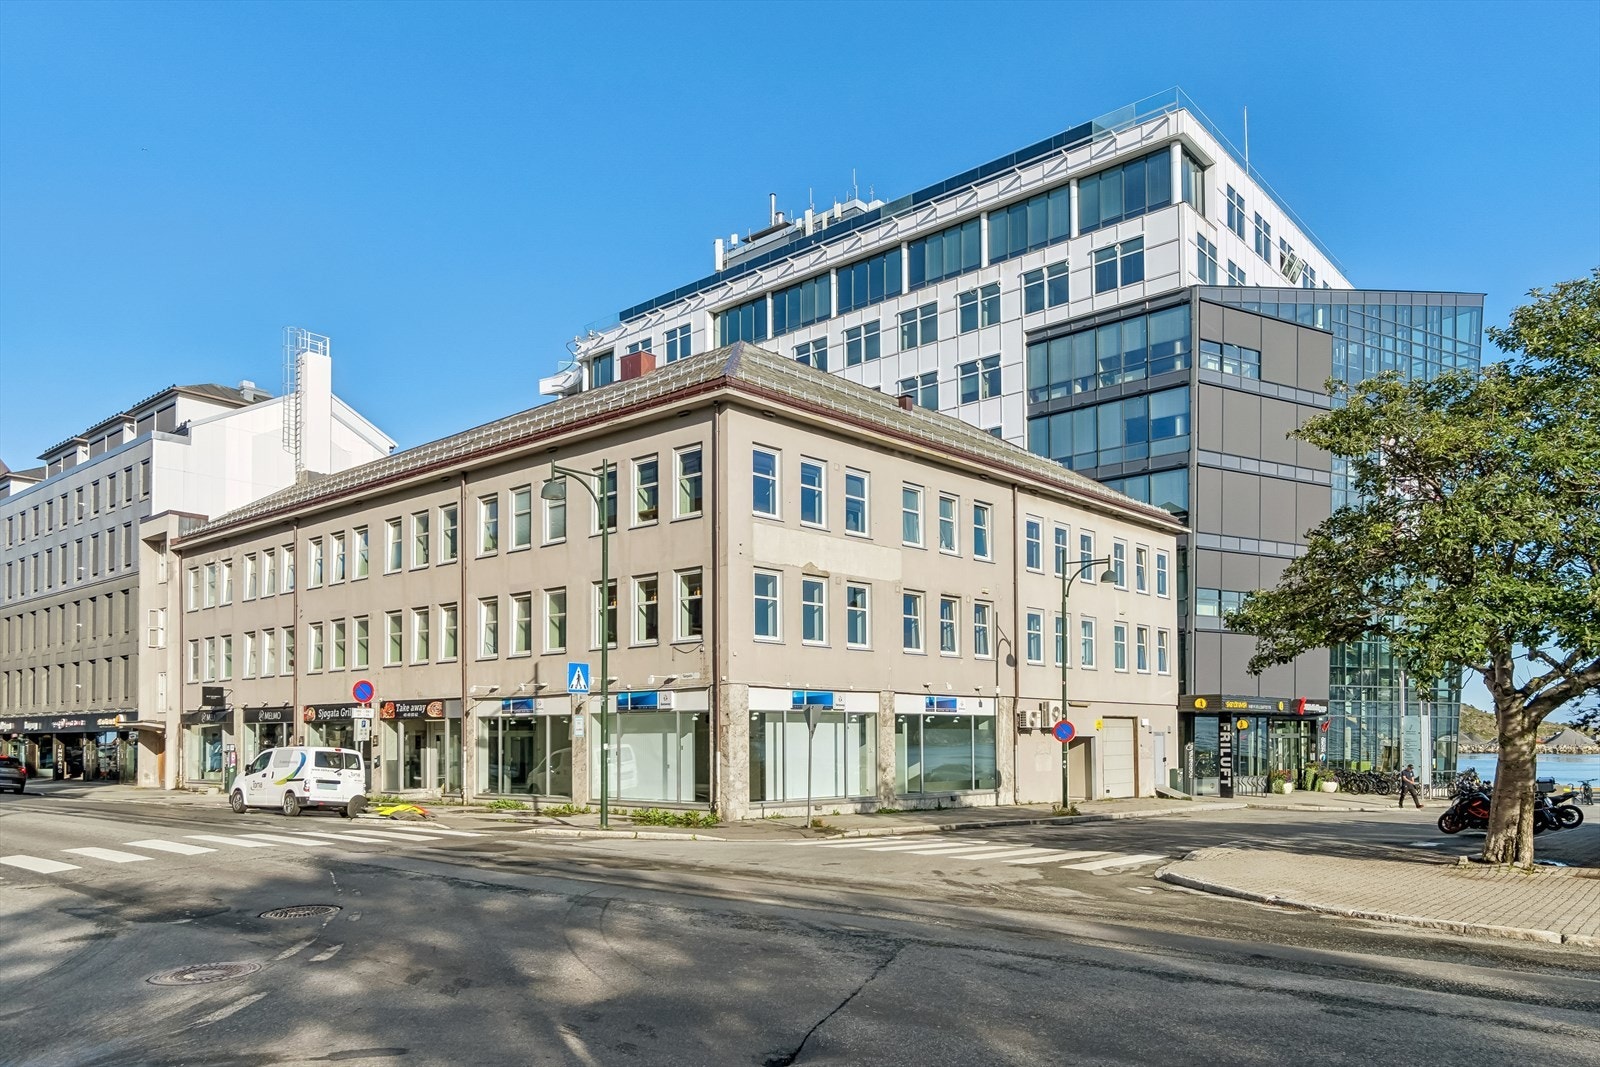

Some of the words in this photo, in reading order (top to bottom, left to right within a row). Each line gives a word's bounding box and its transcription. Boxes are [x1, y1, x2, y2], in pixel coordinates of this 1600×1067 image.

[318, 708, 339, 719] Sjøgata
[340, 707, 352, 717] Gril
[396, 704, 410, 713] Take
[410, 704, 427, 713] away
[1220, 722, 1232, 787] FRILUFT
